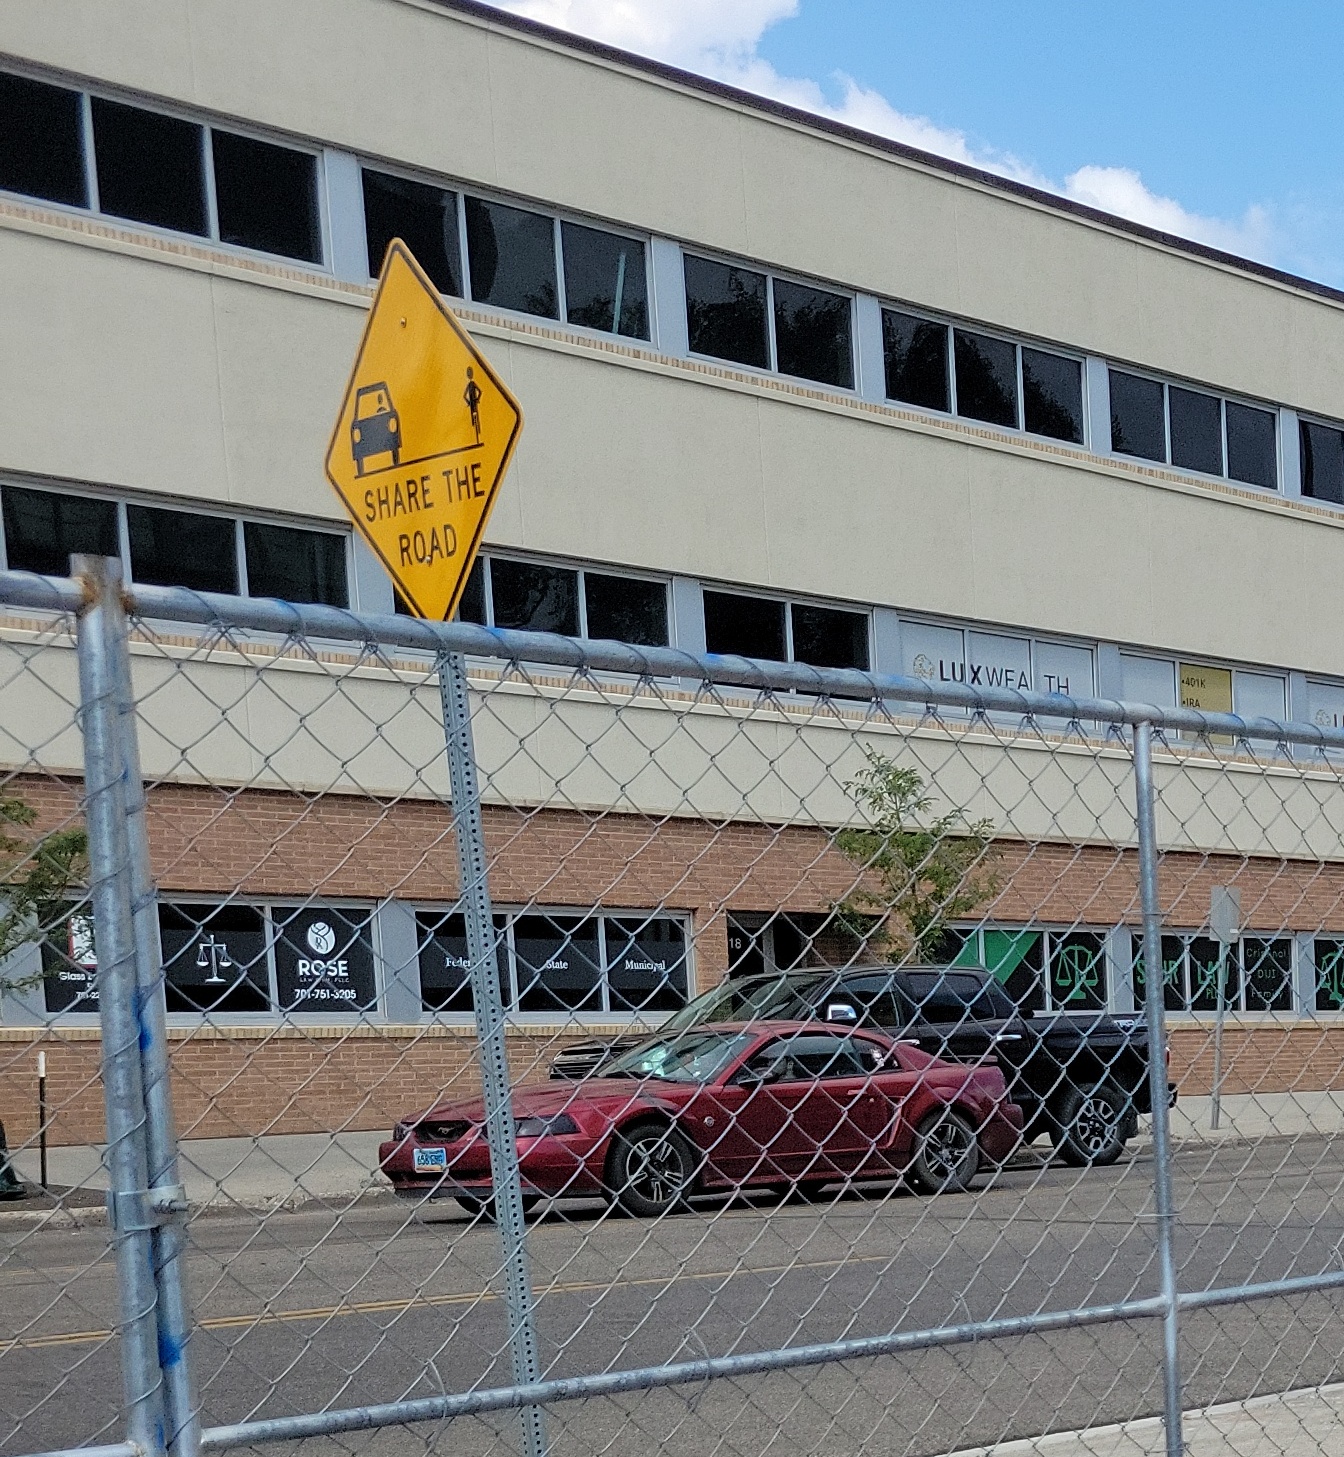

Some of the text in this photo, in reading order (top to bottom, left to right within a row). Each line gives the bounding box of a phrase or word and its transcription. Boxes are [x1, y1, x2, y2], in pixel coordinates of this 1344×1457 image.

[364, 462, 485, 523] SHARE THE
[398, 524, 457, 567] ROAD
[1186, 698, 1201, 708] IRA
[298, 959, 349, 977] ROSE
[546, 959, 568, 969] State
[624, 960, 665, 971] Municipal
[1257, 969, 1277, 979] DUI
[294, 988, 357, 999] 701-751-3205
